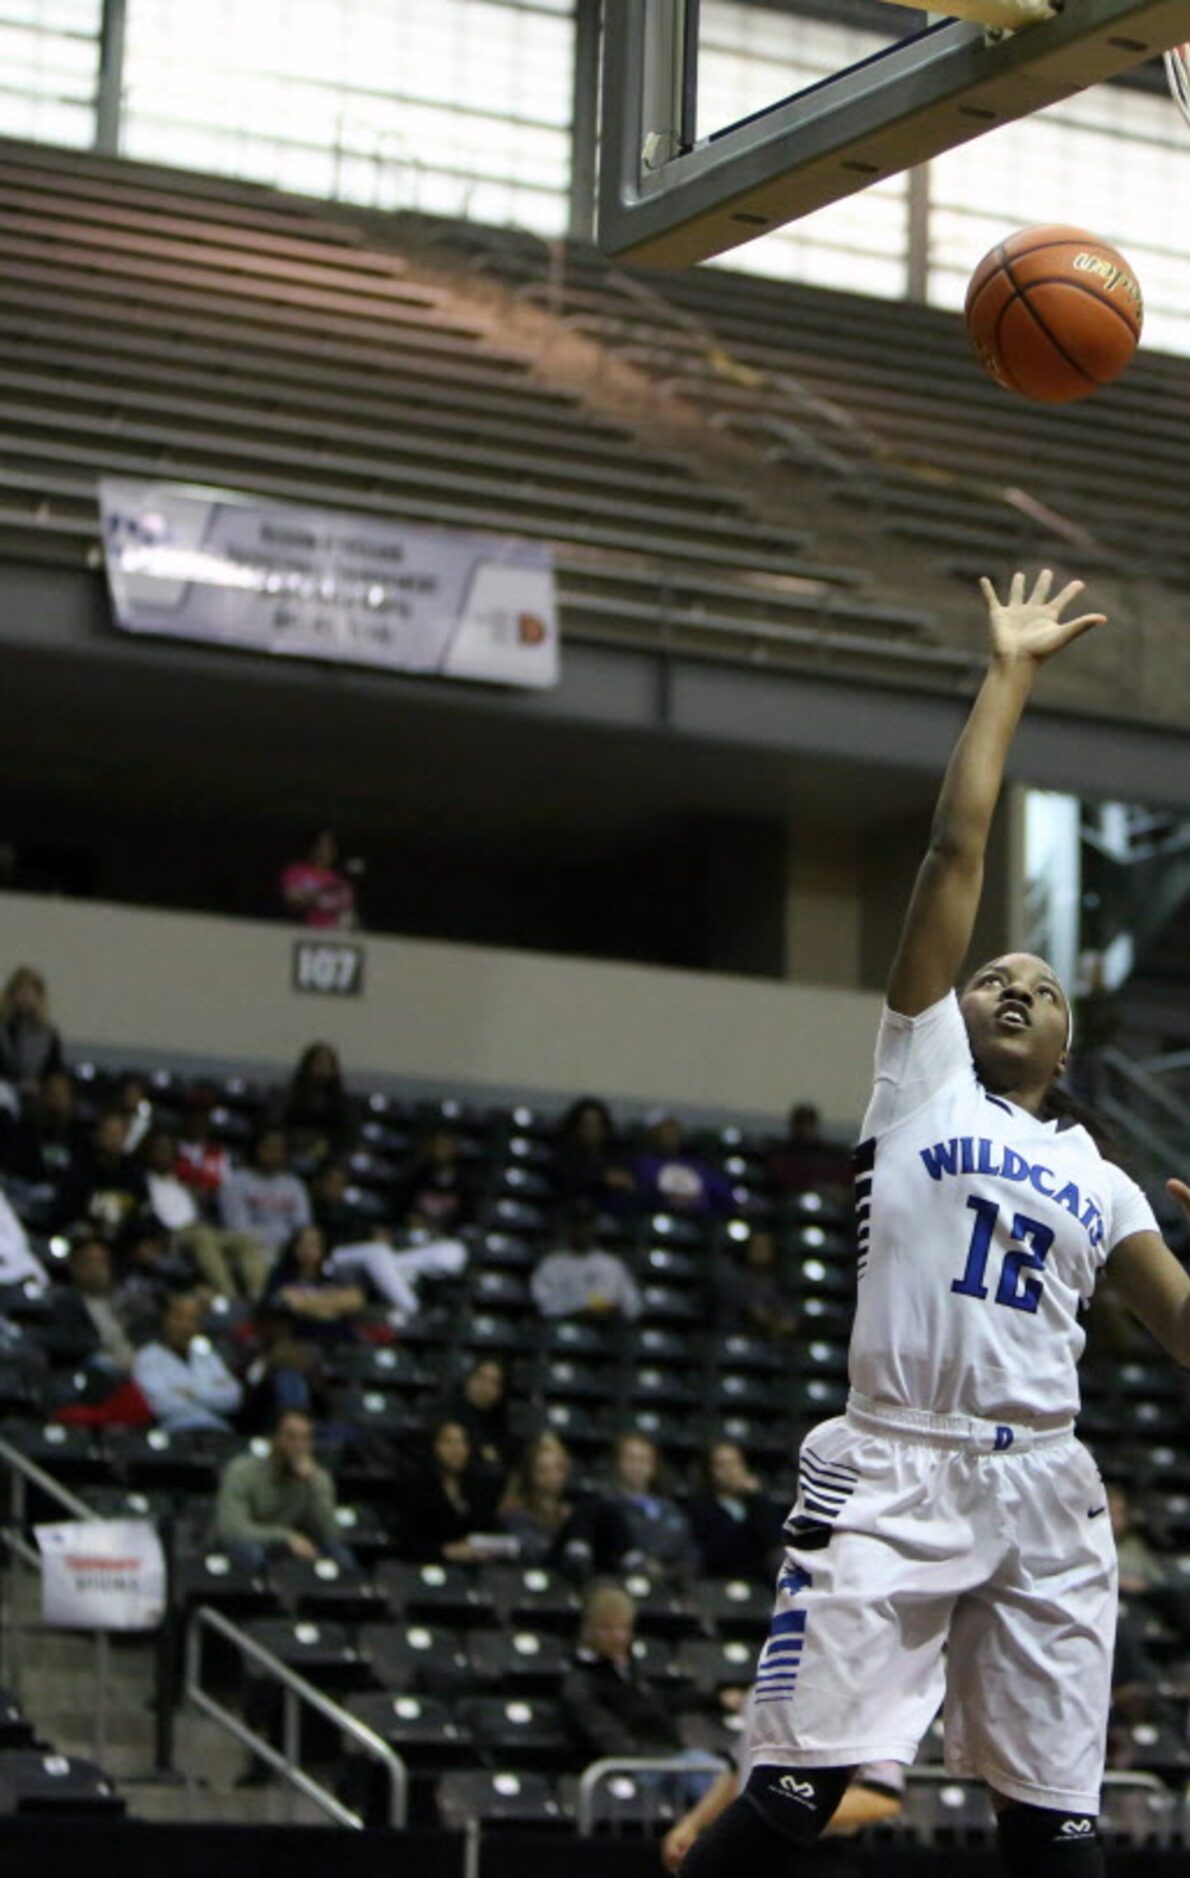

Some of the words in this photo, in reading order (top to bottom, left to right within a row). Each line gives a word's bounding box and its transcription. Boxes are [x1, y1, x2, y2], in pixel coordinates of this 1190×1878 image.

[299, 948, 357, 991] 107
[919, 1136, 1105, 1247] WILDCATS
[950, 1194, 1056, 1315] 12
[992, 1425, 1015, 1452] D
